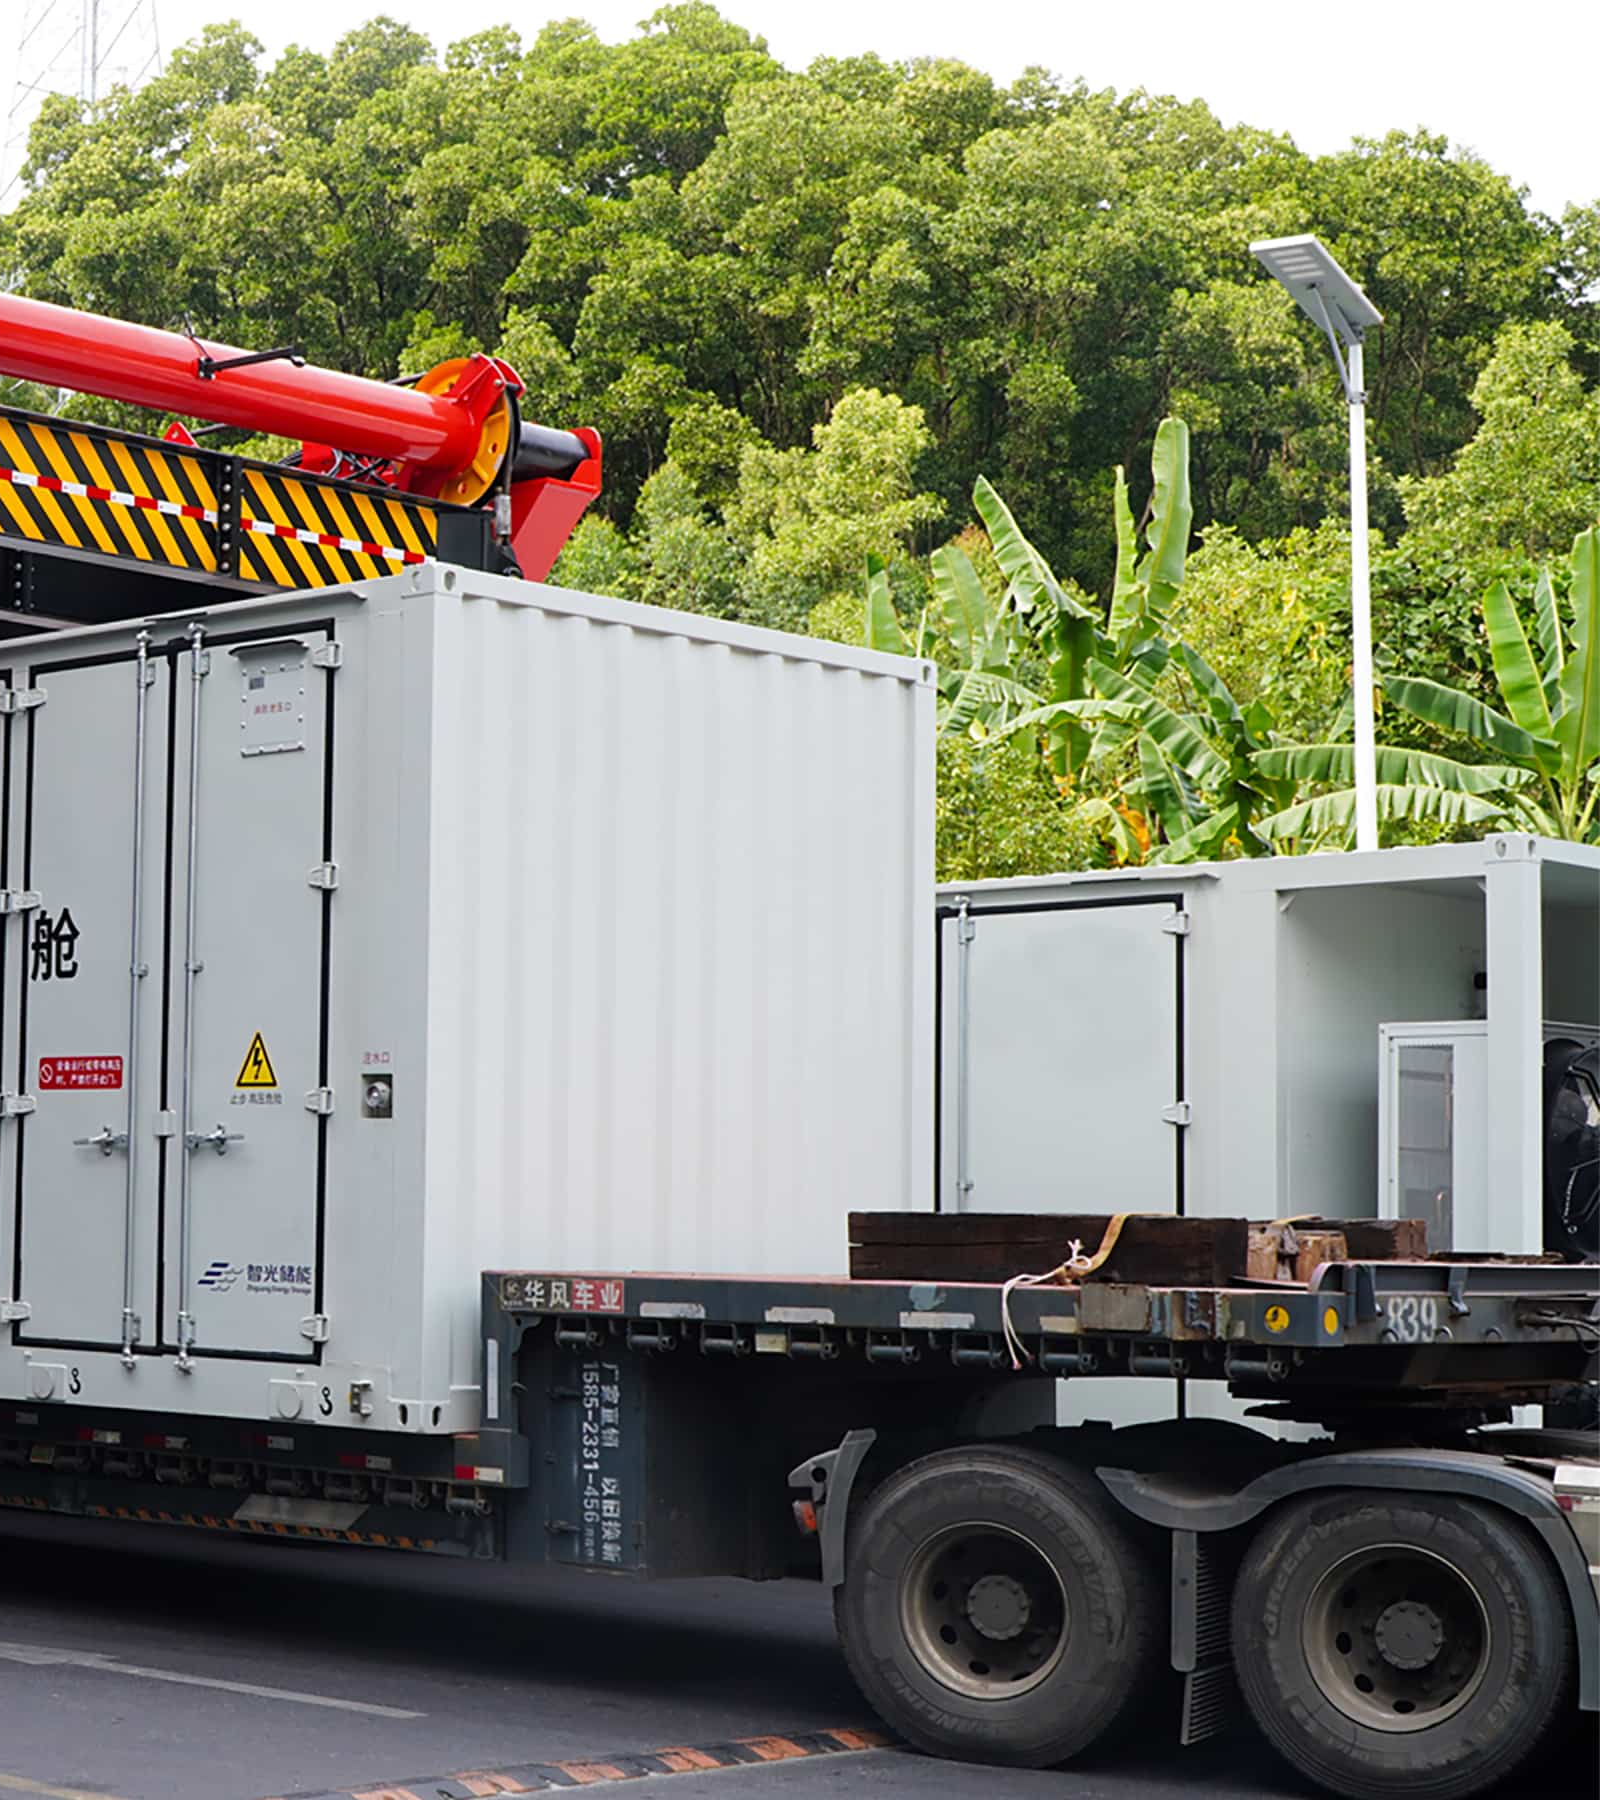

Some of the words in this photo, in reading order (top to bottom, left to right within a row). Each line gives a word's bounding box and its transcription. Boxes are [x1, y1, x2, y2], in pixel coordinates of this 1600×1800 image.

[523, 1280, 621, 1311] 华风车业
[1387, 1296, 1438, 1343] 839
